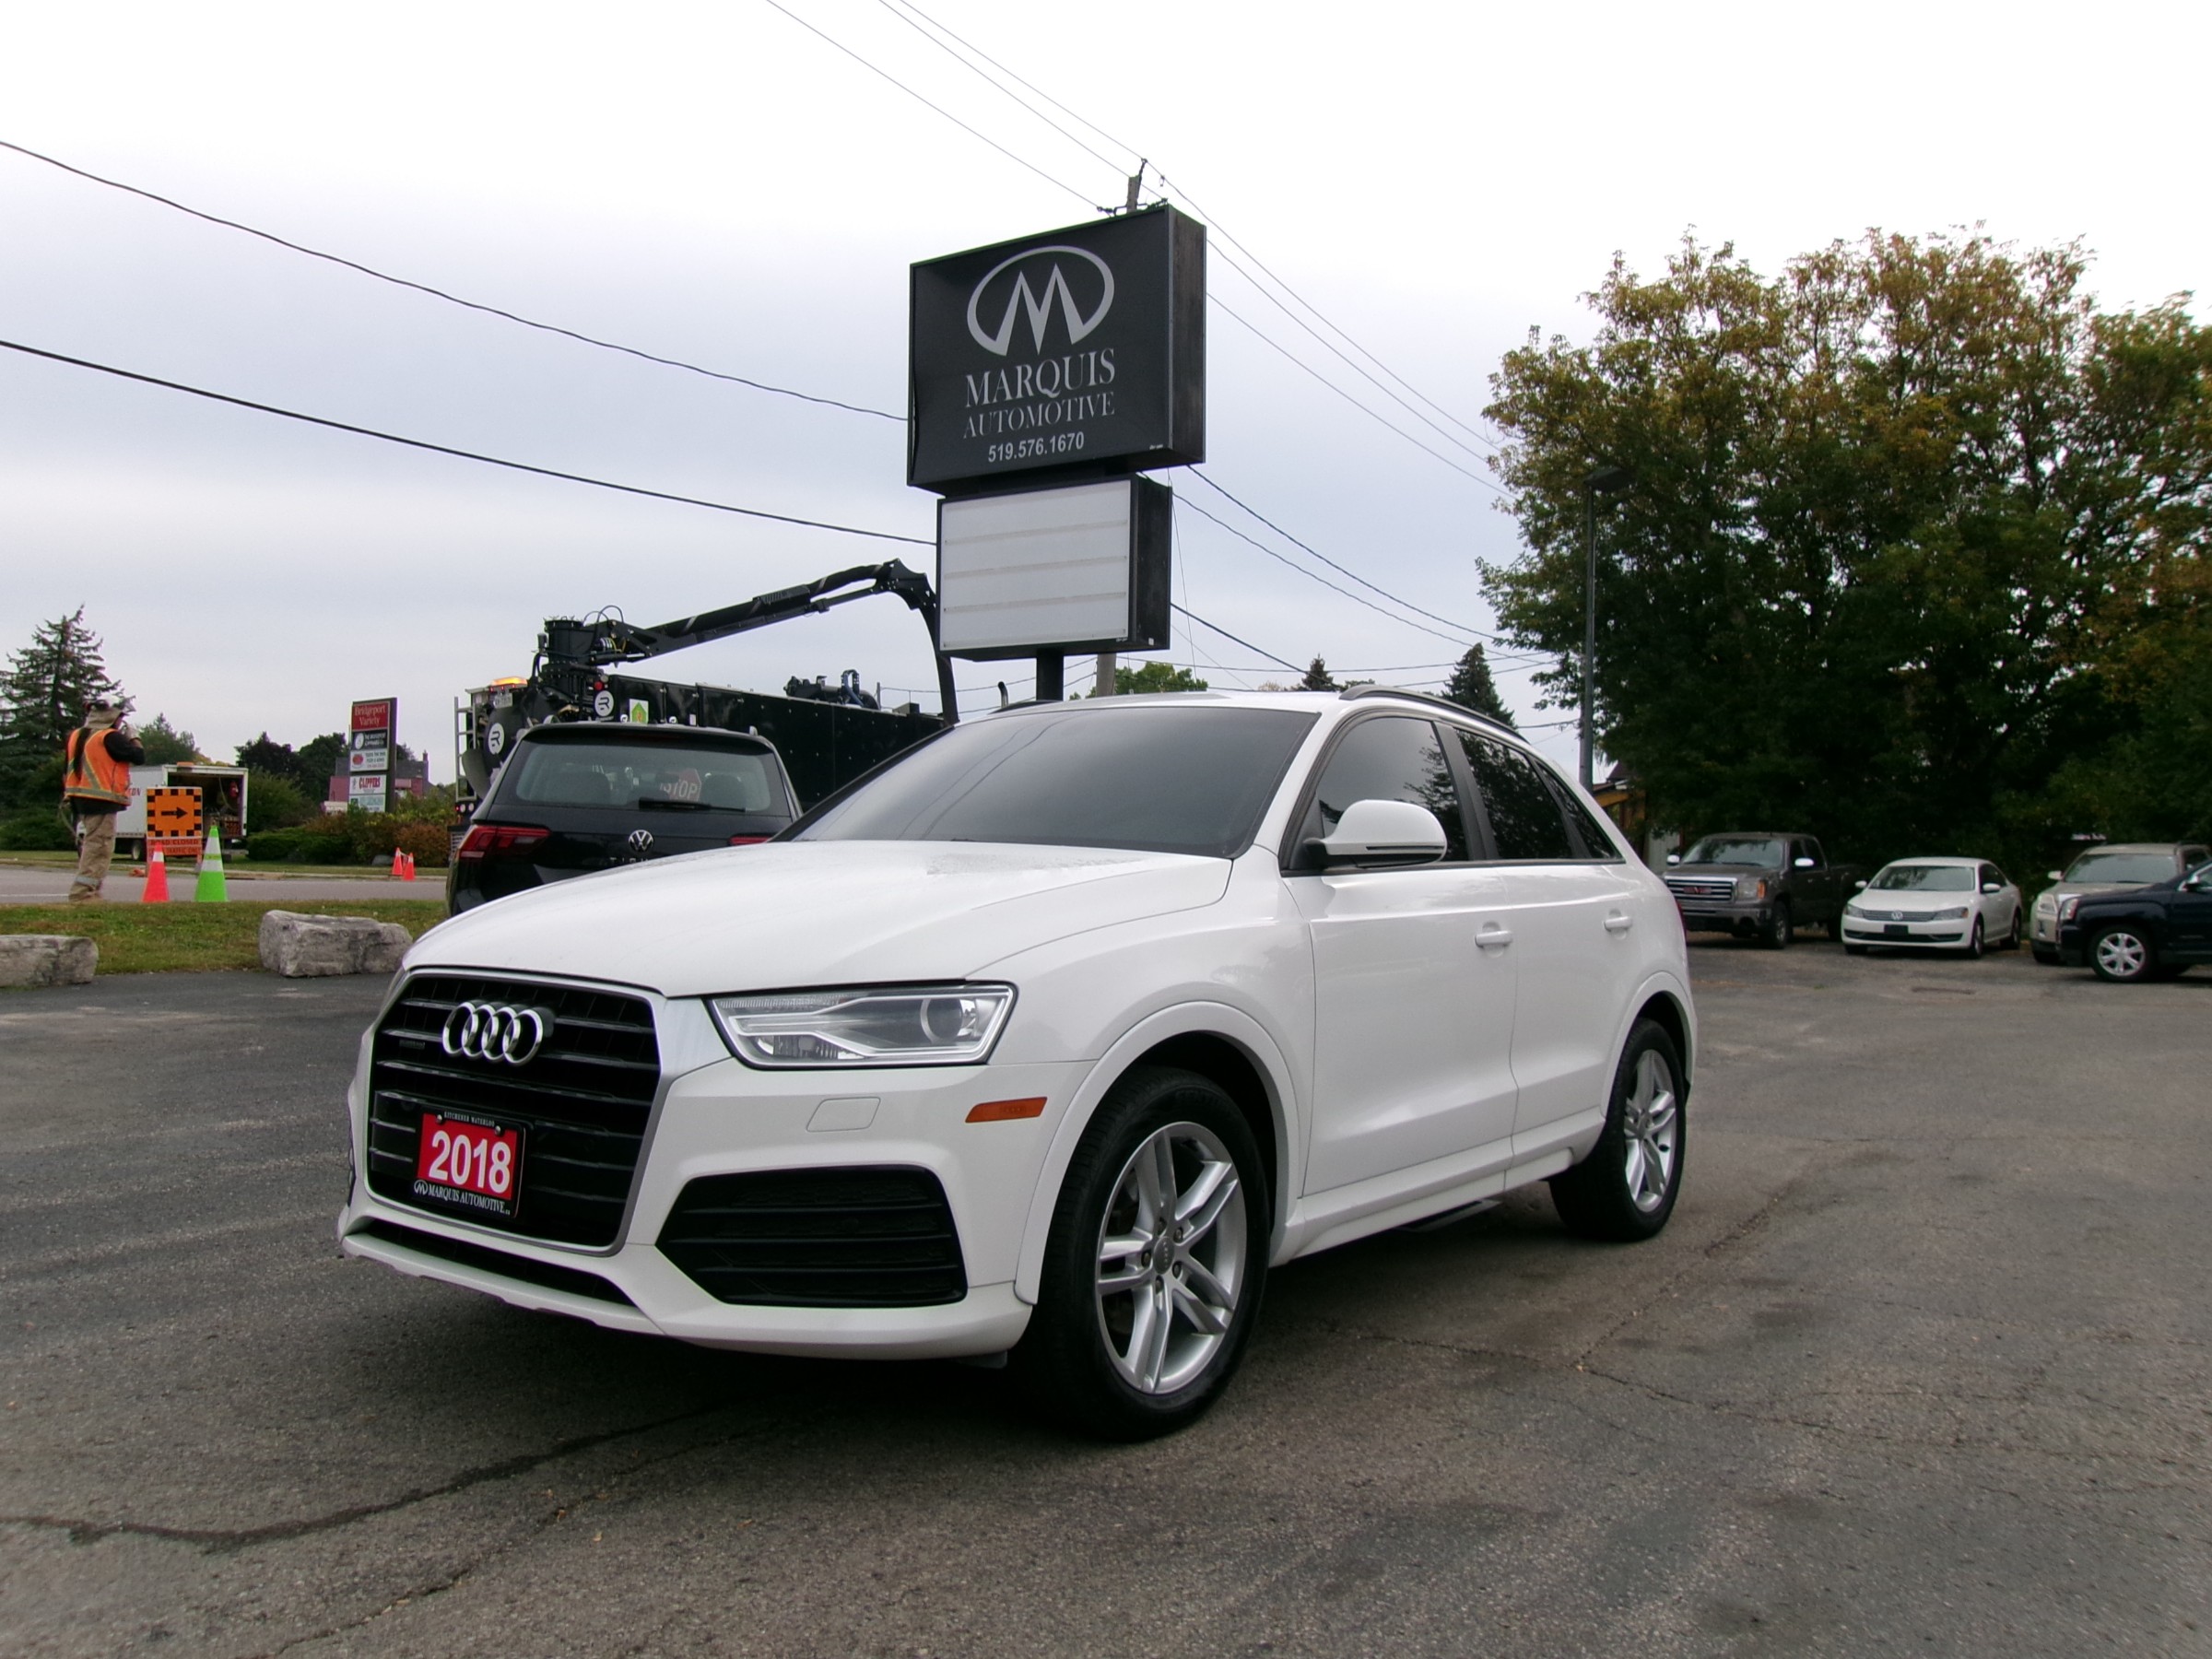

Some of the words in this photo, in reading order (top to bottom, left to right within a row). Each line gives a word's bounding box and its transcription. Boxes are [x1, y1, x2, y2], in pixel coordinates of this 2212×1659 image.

[965, 347, 1115, 407] MARQUIS
[963, 392, 1115, 440] AUTOMOTIVE
[988, 431, 1085, 463] 519.576.1670
[354, 704, 385, 716] Bridgeport
[359, 716, 380, 727] Variety
[359, 776, 381, 790] CLIPPERS
[443, 1111, 470, 1123] KITCHENER
[470, 1116, 495, 1127] WATERLOO
[429, 1130, 512, 1194] 2018
[428, 1183, 460, 1202] MARQUIS
